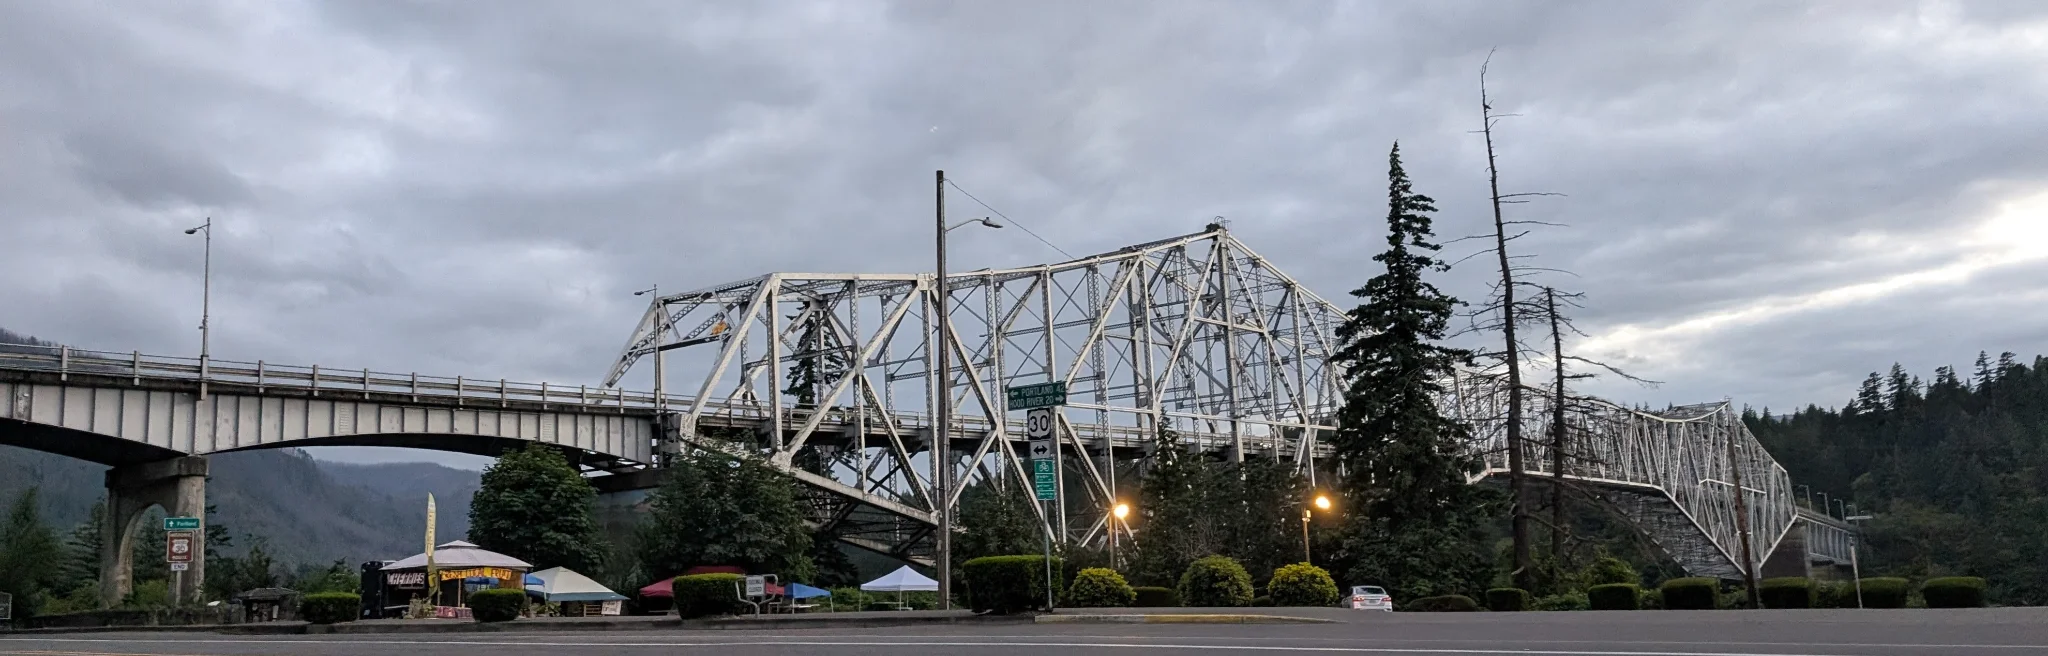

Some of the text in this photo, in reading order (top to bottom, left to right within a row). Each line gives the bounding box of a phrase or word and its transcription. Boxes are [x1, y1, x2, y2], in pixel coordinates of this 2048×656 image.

[1021, 384, 1065, 397] PORTLAND 42
[1009, 396, 1054, 409] HOOD RIVER 20
[1029, 415, 1048, 432] 30
[175, 545, 186, 553] 30
[387, 572, 425, 585] CHERRIES
[490, 568, 512, 580] FRUIT
